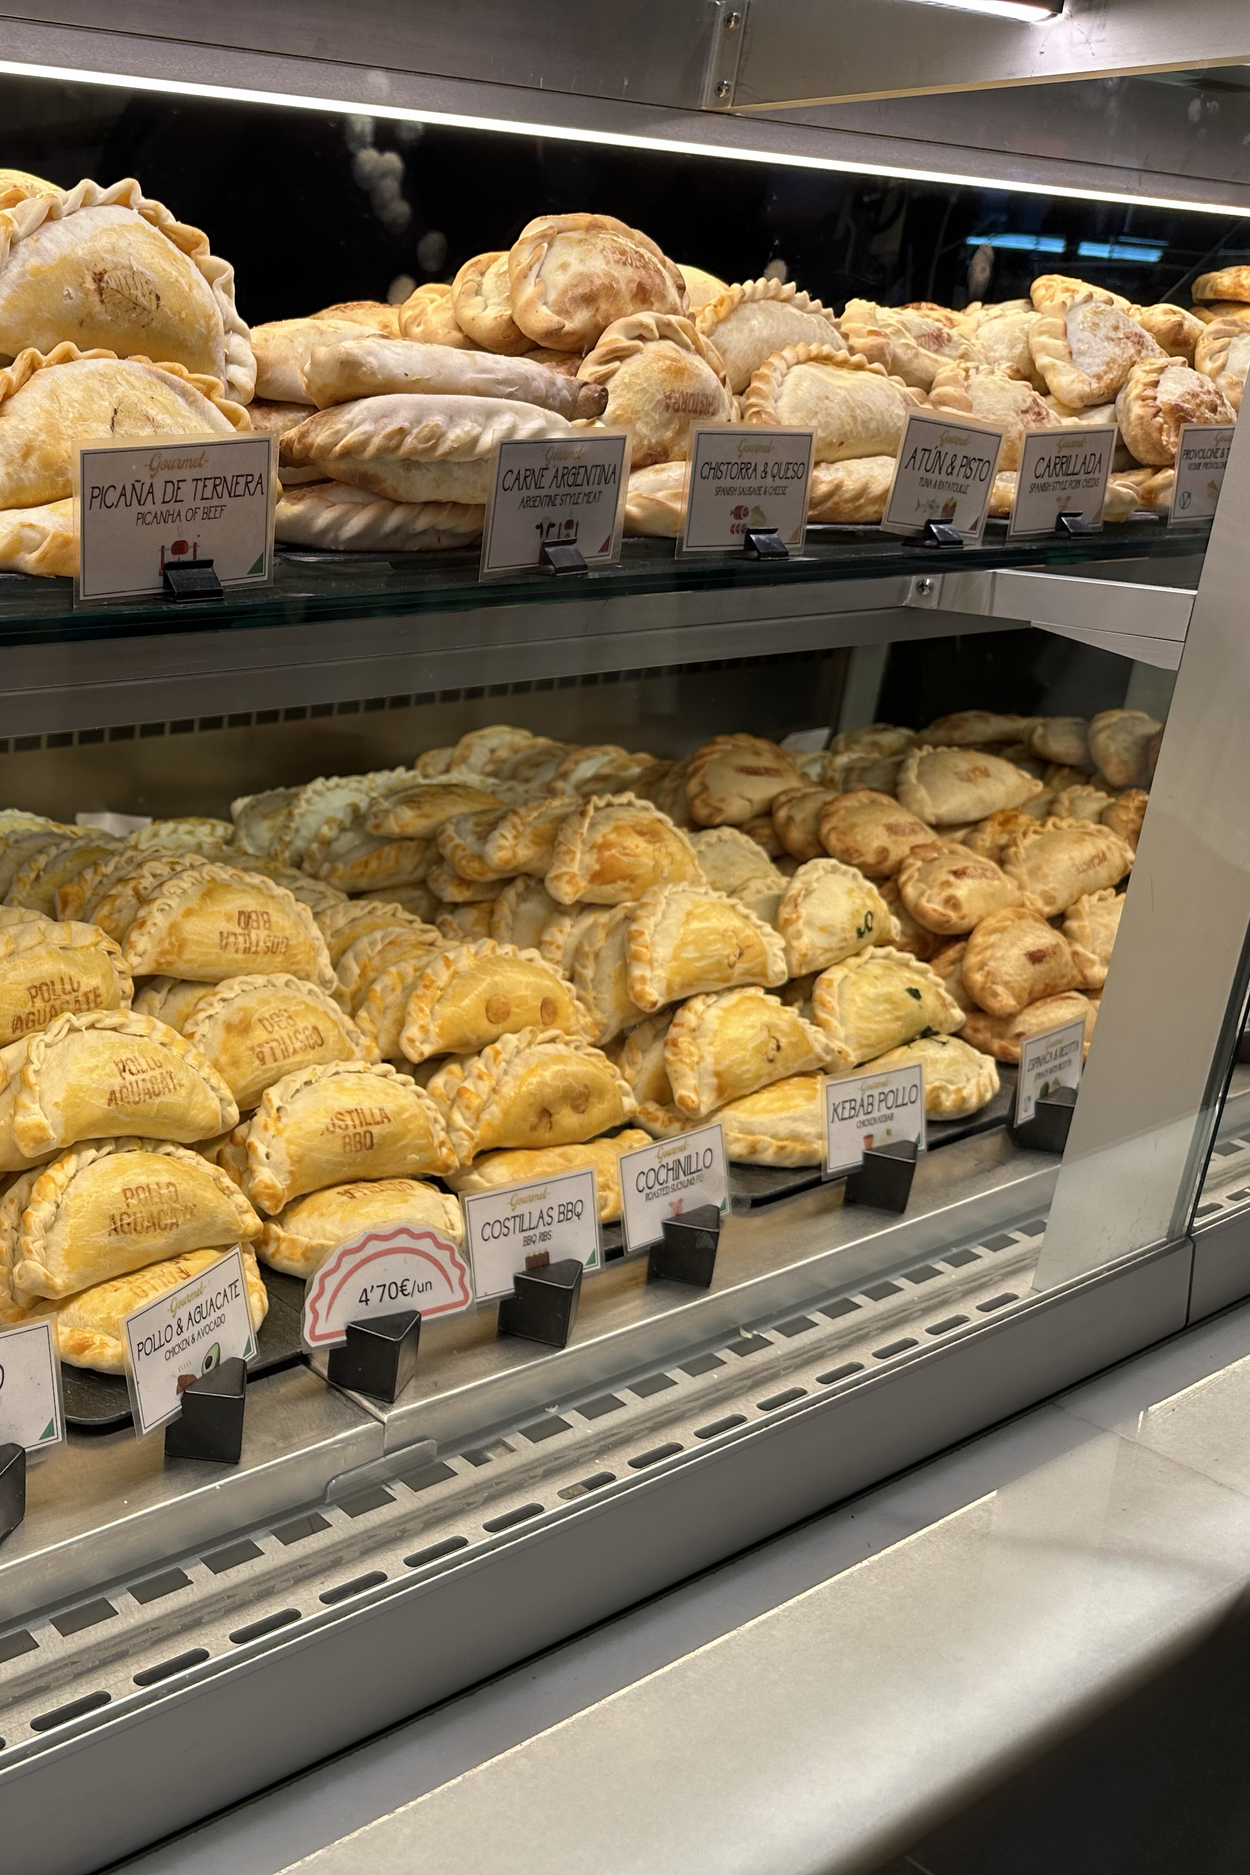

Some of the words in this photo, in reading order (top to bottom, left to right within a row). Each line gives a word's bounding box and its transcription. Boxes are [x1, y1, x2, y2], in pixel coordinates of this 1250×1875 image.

[502, 467, 549, 491] CARNE
[549, 463, 617, 489] ARGENTINA
[700, 461, 759, 481] CHISTORRA
[760, 461, 769, 480] &
[770, 461, 806, 482] QUESO
[904, 445, 948, 476] ATÚN
[945, 453, 959, 476] &
[956, 455, 991, 482] PISTO
[1034, 453, 1103, 479] CARRILLADA
[89, 478, 157, 510] PICAÑA
[161, 478, 187, 504] DE
[191, 473, 265, 502] TERNERA
[518, 494, 560, 510] ARGENTINE
[558, 492, 583, 506] STYLE
[581, 490, 603, 505] MEAT
[135, 508, 182, 526] PICANHA
[185, 507, 202, 522] OF
[201, 504, 227, 521] BEEF
[831, 1094, 875, 1123] KEBAB
[877, 1084, 919, 1112] POLLO
[320, 1107, 392, 1136] OSTILLA
[636, 1147, 713, 1193] COCHINILLO
[481, 1206, 554, 1242] COSTILLAS
[556, 1199, 585, 1224] BBQ
[522, 1233, 538, 1247] BBQ
[538, 1230, 553, 1243] RIBS
[137, 1324, 174, 1361] POLLO
[176, 1317, 185, 1337] &
[186, 1279, 241, 1331] AGUACATE
[164, 1335, 192, 1361] CHICKEN
[196, 1313, 226, 1341] AVOCADO
